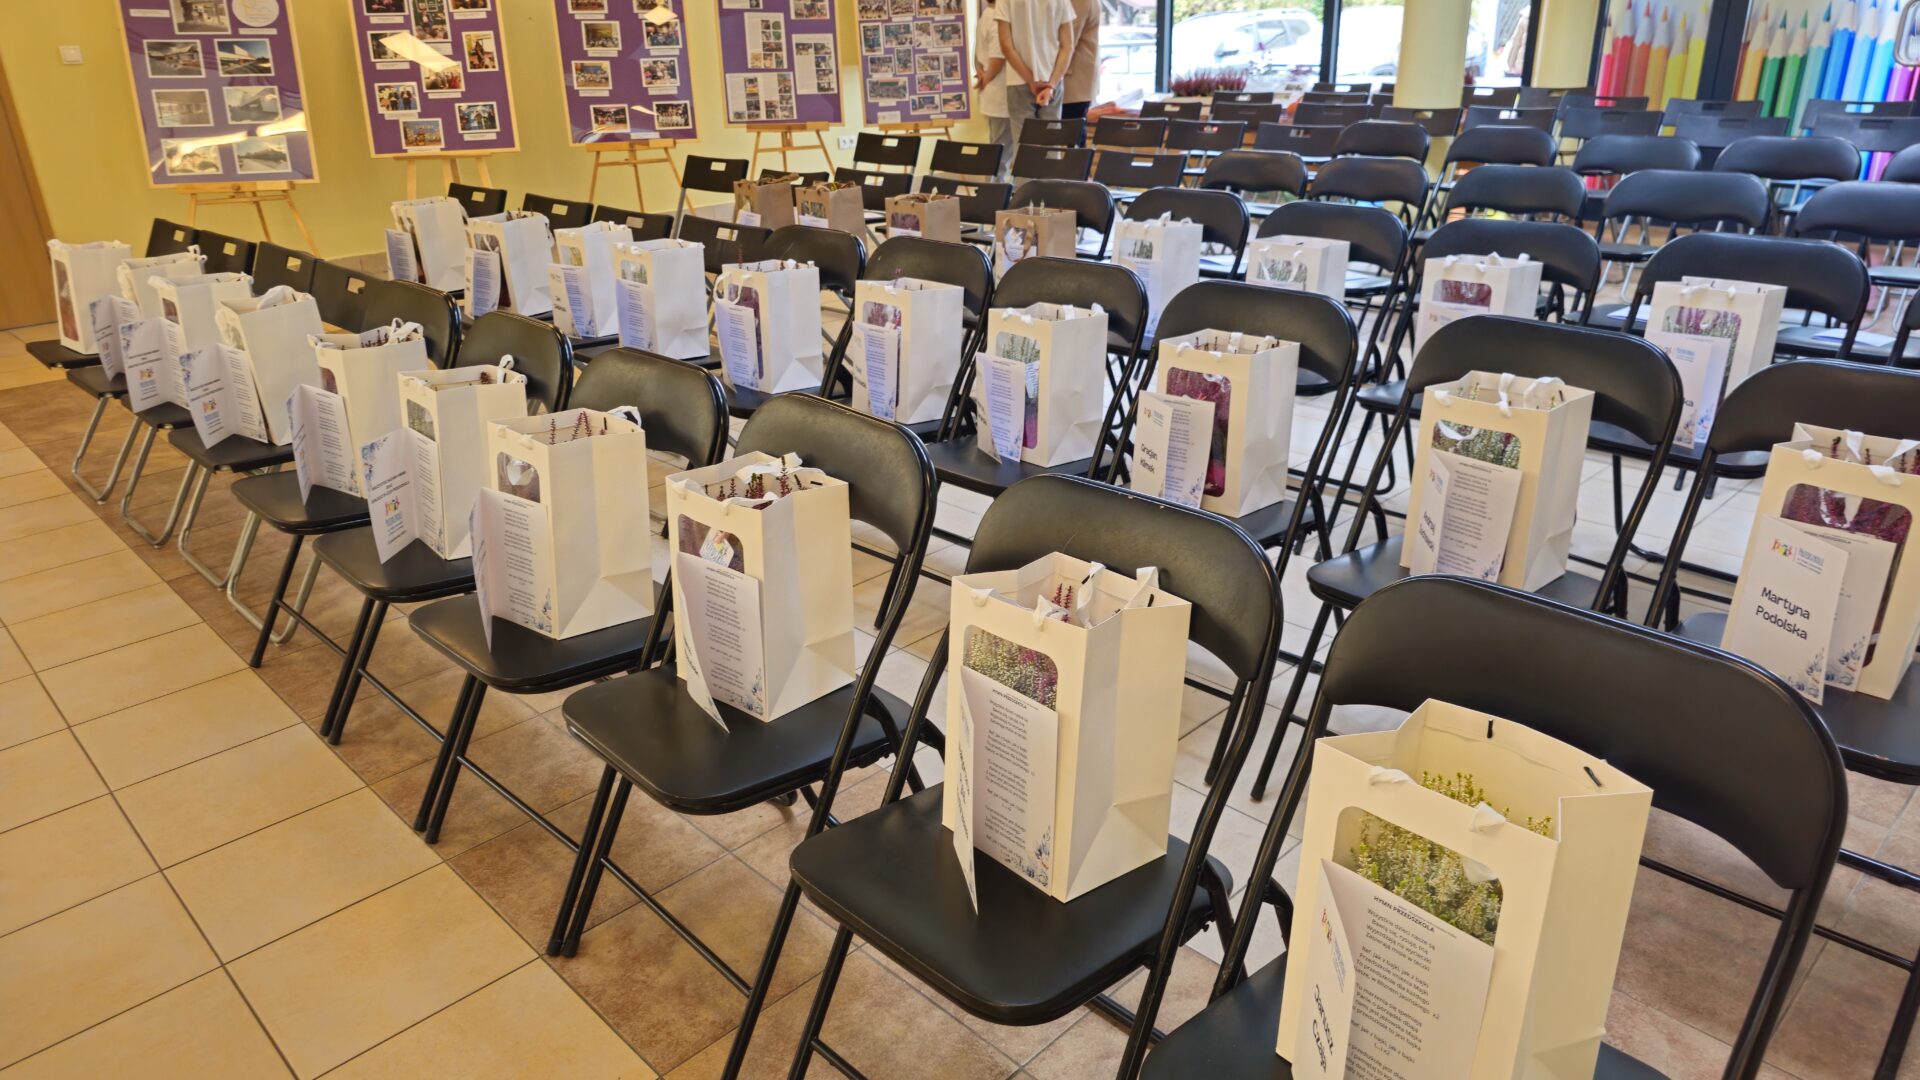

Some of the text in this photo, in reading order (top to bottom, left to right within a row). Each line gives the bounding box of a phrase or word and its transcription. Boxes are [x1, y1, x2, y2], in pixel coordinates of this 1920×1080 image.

[1760, 586, 1811, 620] Martyna
[1755, 604, 1809, 640] Podolska
[1373, 895, 1393, 910] HYMN
[1392, 905, 1436, 934] PRZEDSZKOLA
